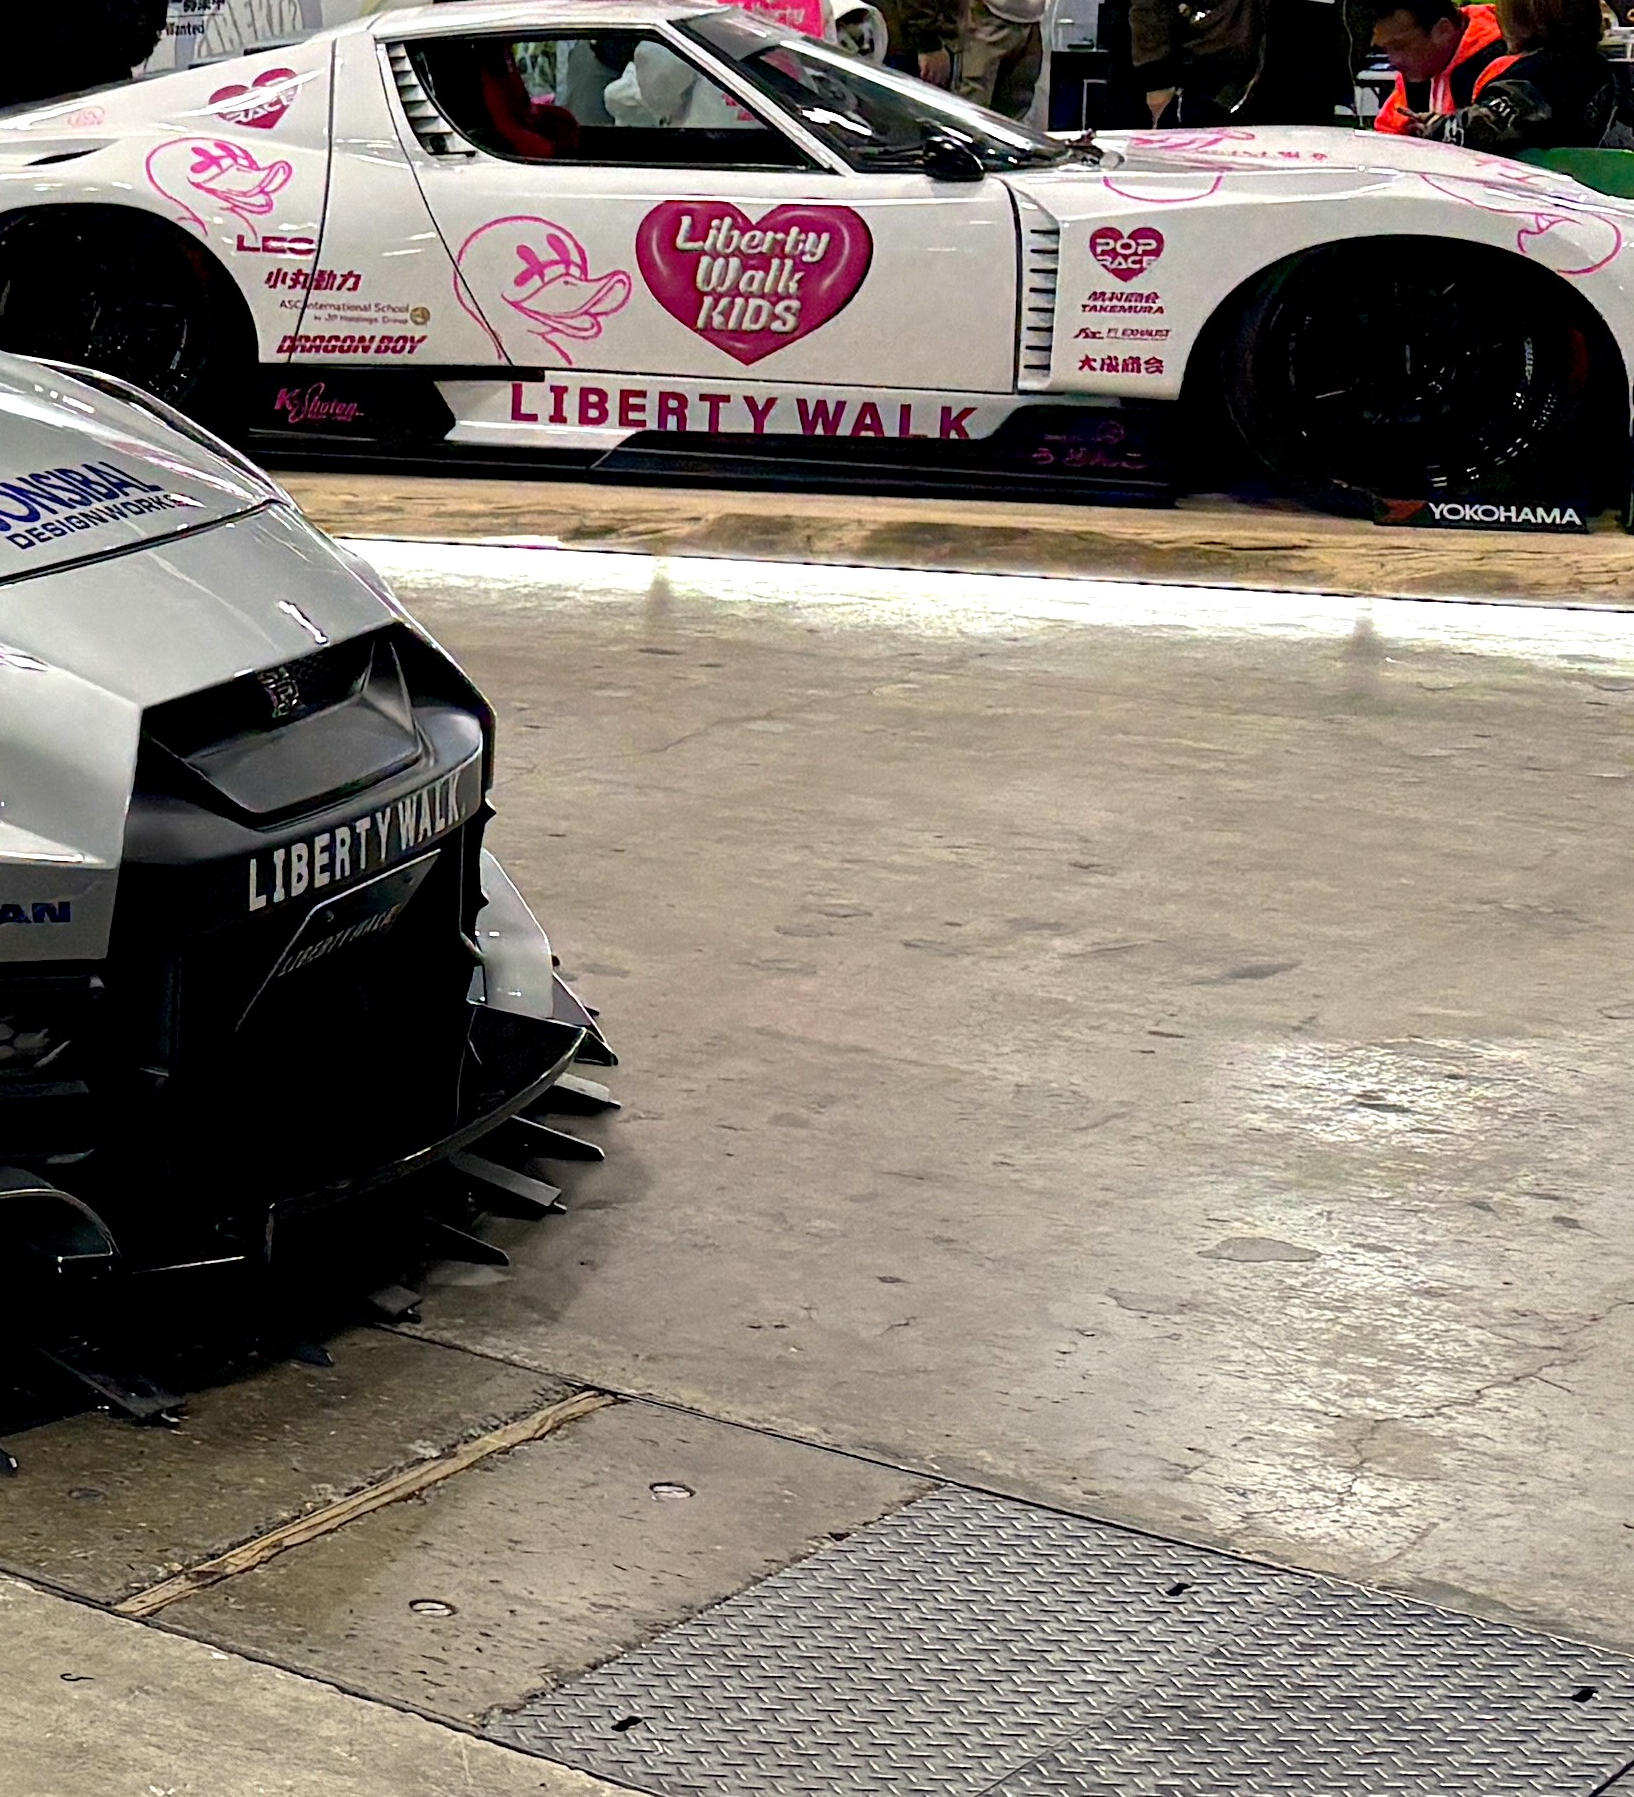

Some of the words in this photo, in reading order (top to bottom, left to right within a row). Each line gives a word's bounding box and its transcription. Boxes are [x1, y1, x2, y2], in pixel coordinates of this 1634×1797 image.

[676, 215, 830, 263] Liberty
[1096, 239, 1157, 255] POP
[696, 255, 806, 296] Walk
[375, 303, 409, 314] School
[695, 296, 801, 332] KIDS
[1081, 304, 1165, 315] TAKEMURA
[276, 335, 375, 354] DRAGON
[375, 335, 428, 354] BOY
[1078, 354, 1164, 375] 大成商会
[510, 382, 781, 436] LIBERTY
[796, 396, 978, 440] WALK
[5, 493, 179, 550] DESIGNWORKS
[1429, 502, 1582, 527] YOKOHAMA
